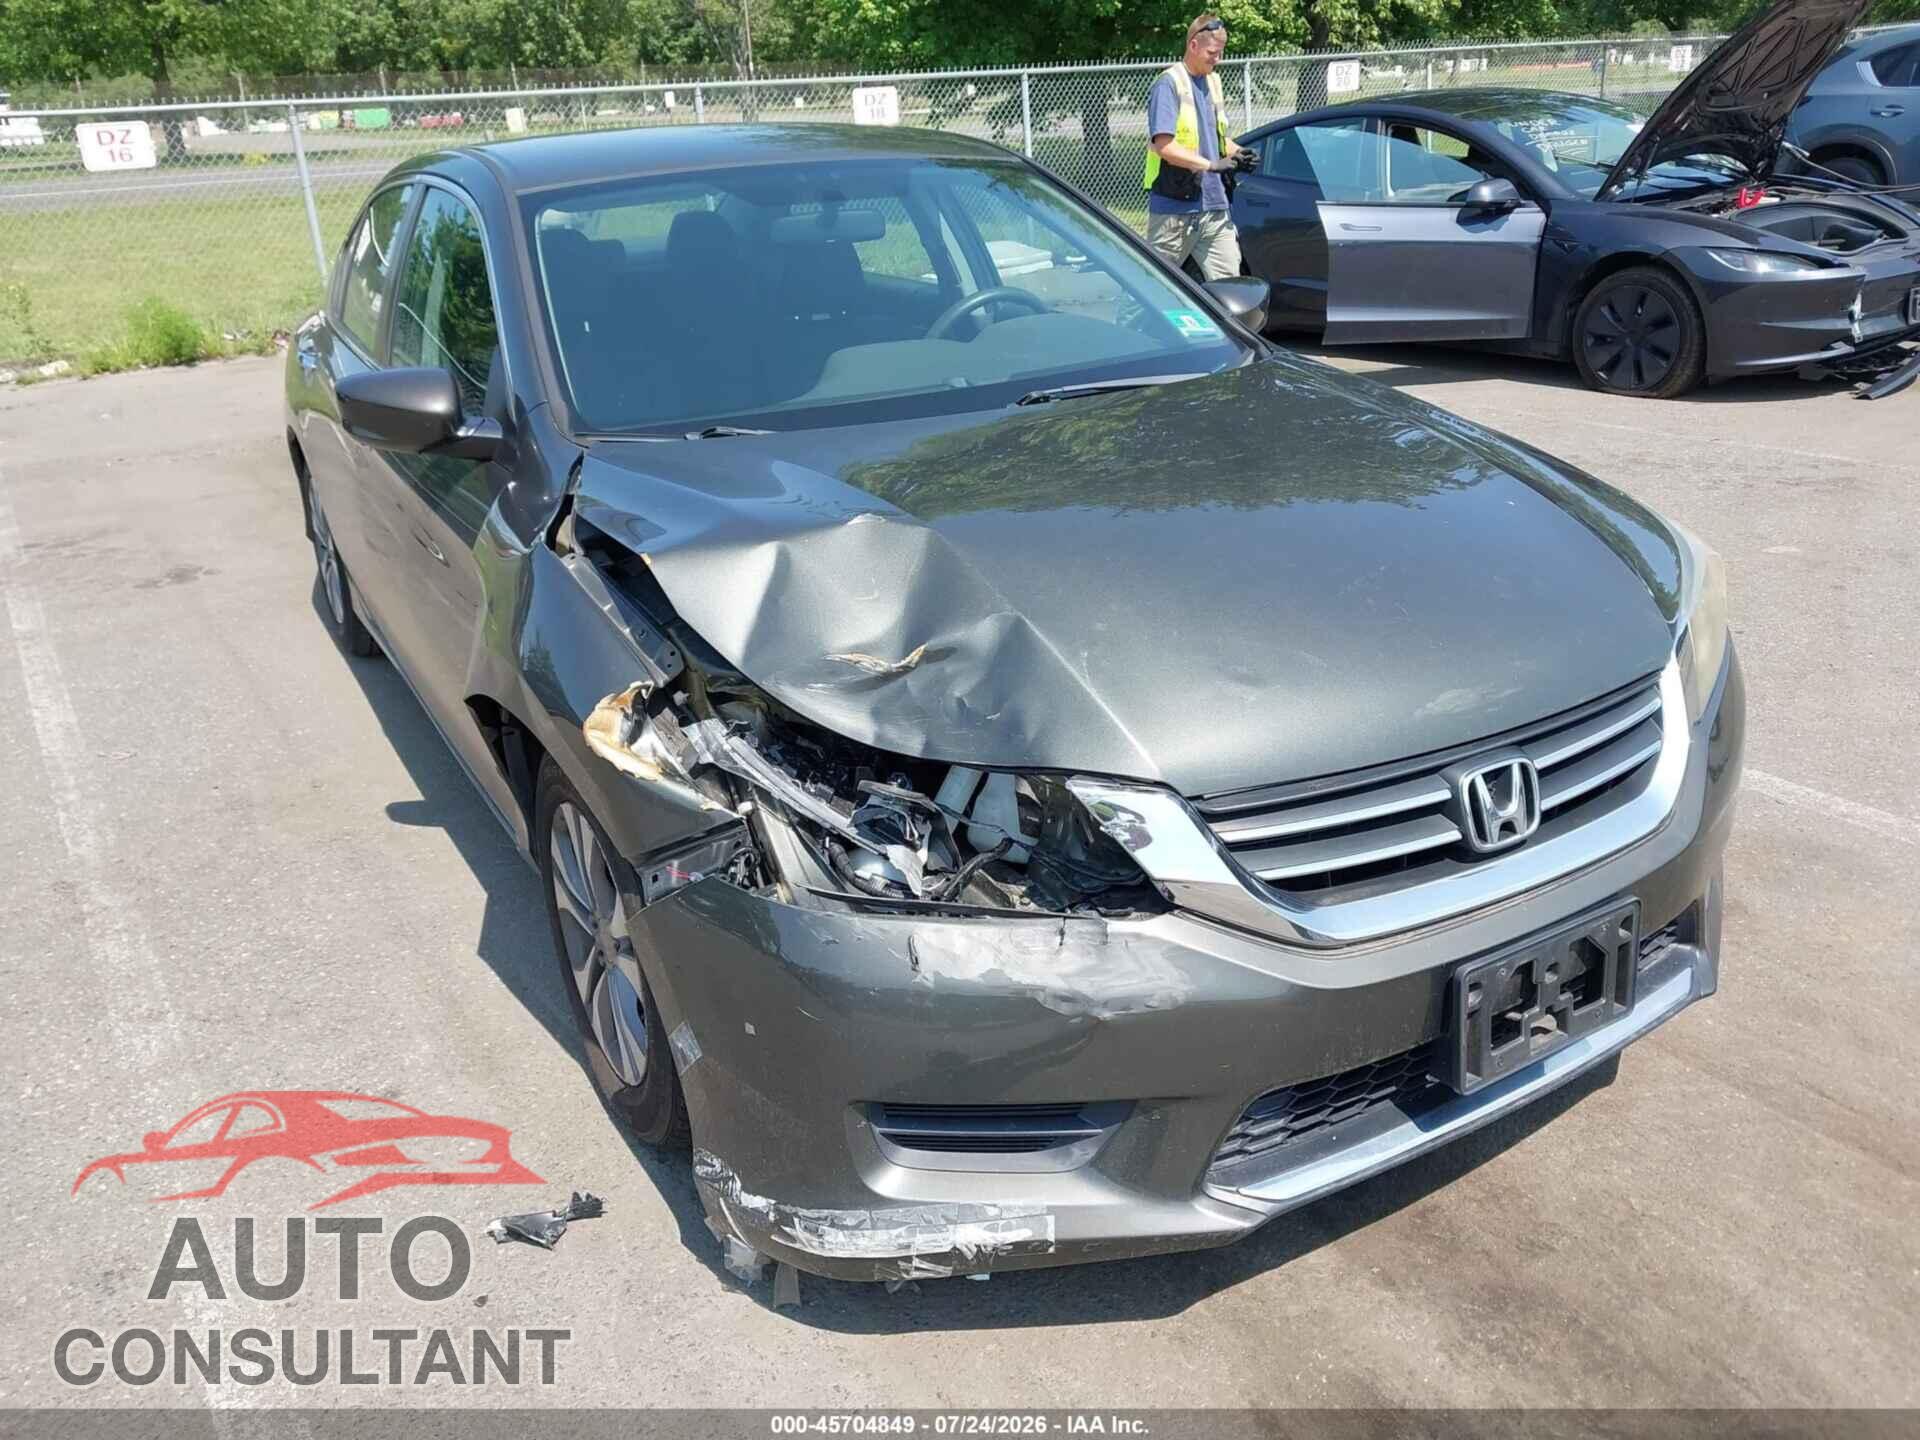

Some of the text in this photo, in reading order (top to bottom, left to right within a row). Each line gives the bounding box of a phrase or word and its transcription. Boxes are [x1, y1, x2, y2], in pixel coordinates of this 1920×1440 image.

[1335, 64, 1352, 77] DZ
[864, 93, 887, 106] DZ
[96, 128, 136, 146] DZ
[107, 147, 134, 163] 16
